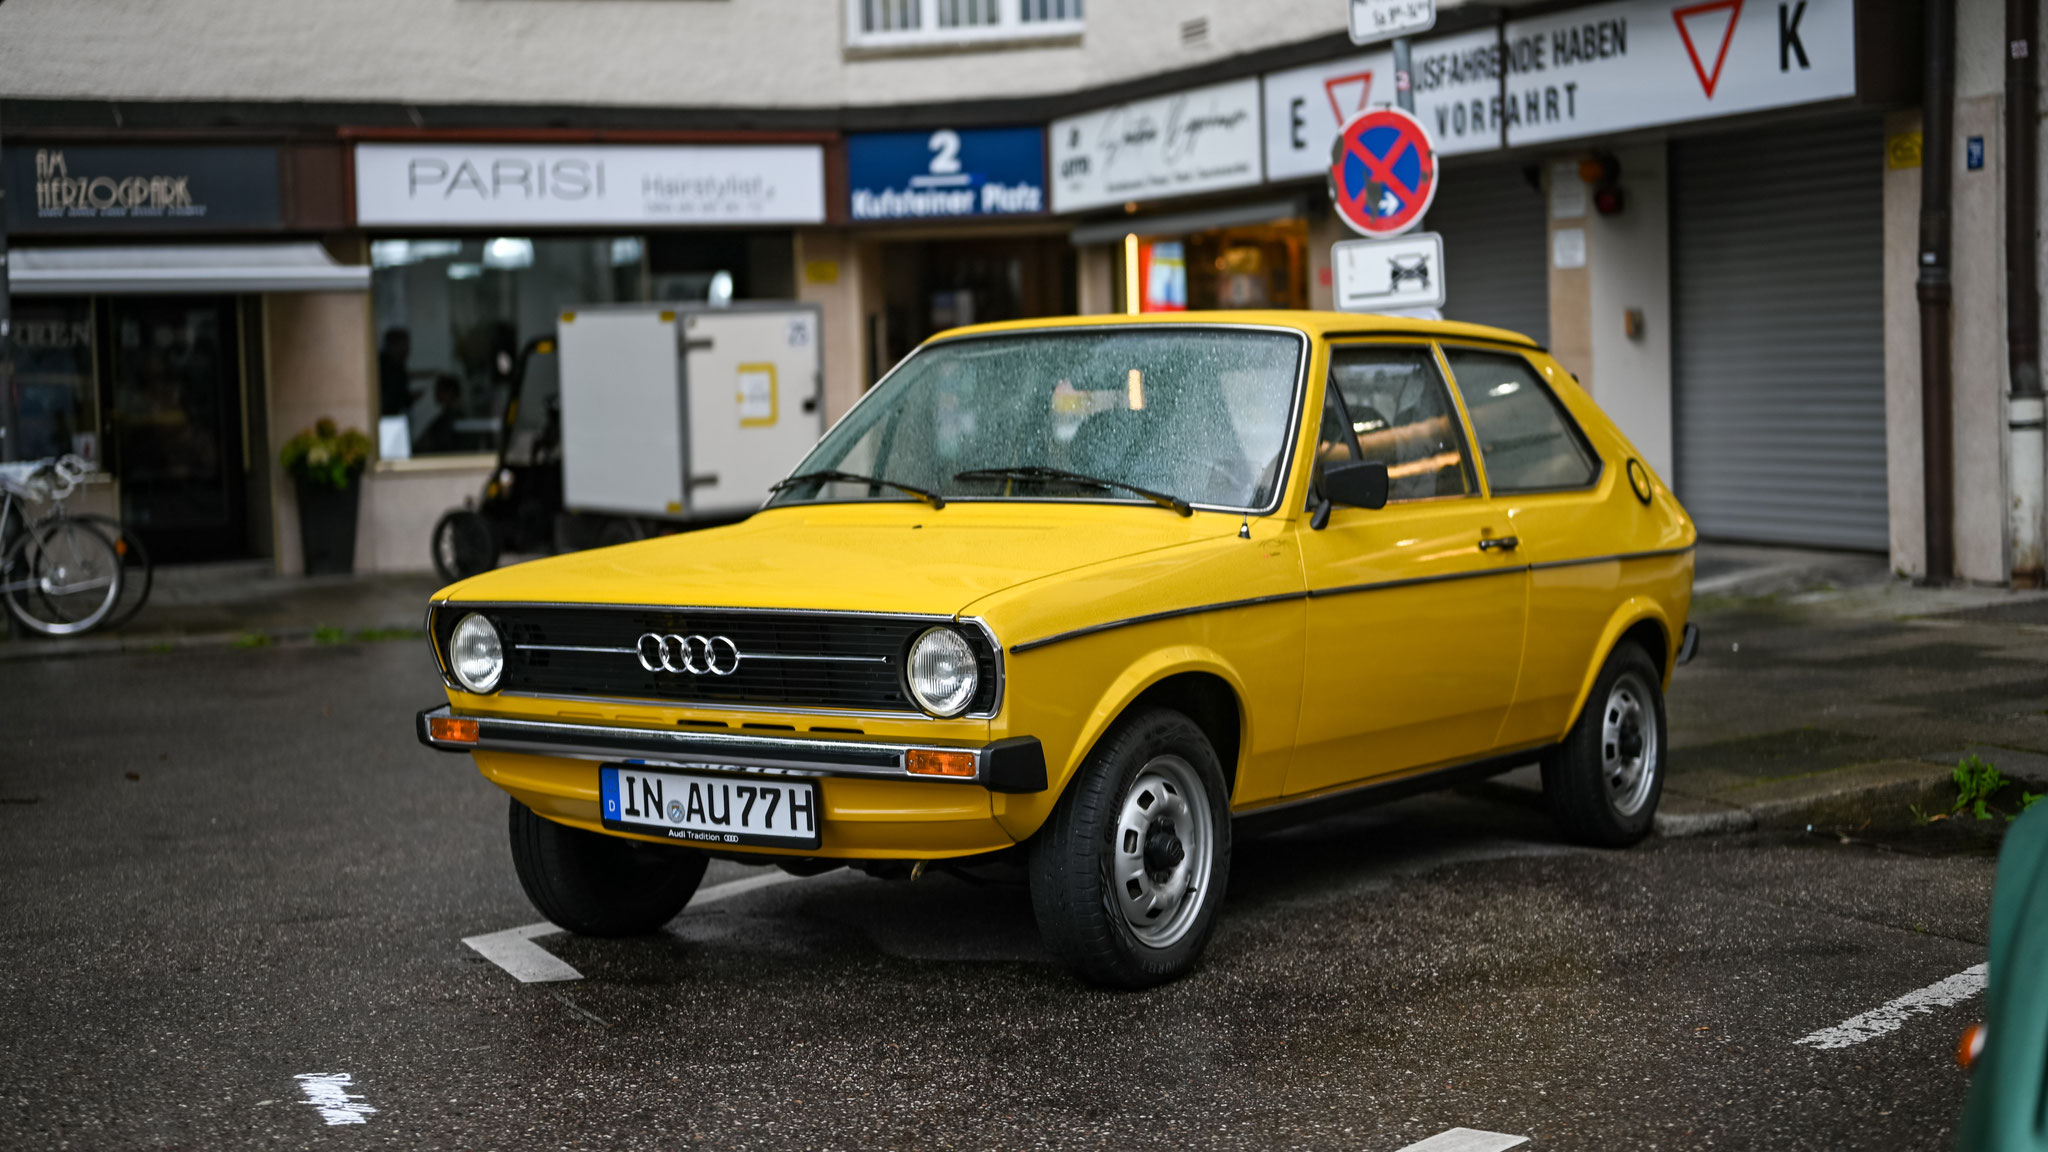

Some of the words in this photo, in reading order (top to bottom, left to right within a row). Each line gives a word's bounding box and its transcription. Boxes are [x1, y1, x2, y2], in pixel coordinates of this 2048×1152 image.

[1413, 33, 1546, 91] USFAHRENDE
[1552, 17, 1628, 67] HABEN
[1778, 0, 1811, 73] K
[1291, 97, 1306, 150] E
[1435, 81, 1577, 139] VORFAHRT
[36, 149, 68, 179] AM
[928, 130, 961, 174] 2
[37, 176, 192, 208] HERZOGPARK
[408, 158, 606, 200] PARISI
[851, 186, 975, 219] Kufsteiner
[981, 180, 1042, 213] Platz
[608, 800, 616, 812] D
[625, 775, 664, 819] IN
[668, 829, 686, 839] Audi
[687, 830, 720, 842] Tradition
